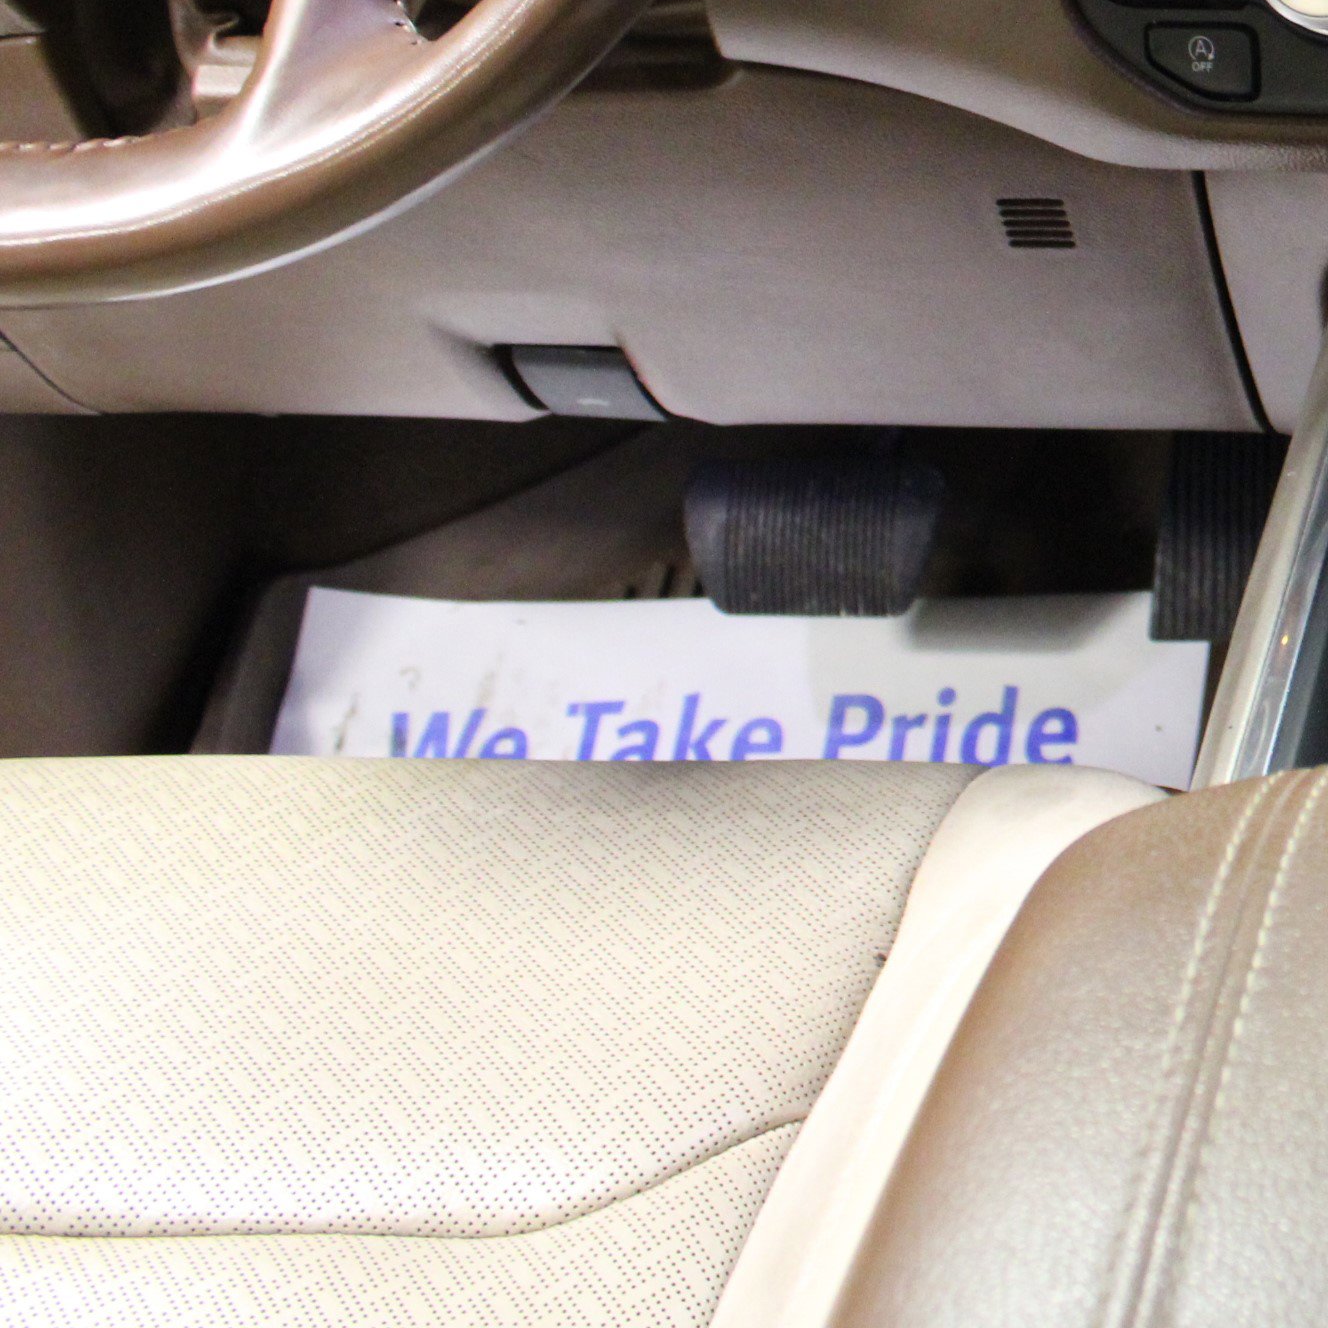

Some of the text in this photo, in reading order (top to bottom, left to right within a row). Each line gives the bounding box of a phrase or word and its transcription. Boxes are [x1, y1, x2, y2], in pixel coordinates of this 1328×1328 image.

[1191, 61, 1213, 72] OFF
[390, 685, 1078, 767] We Take Pride
